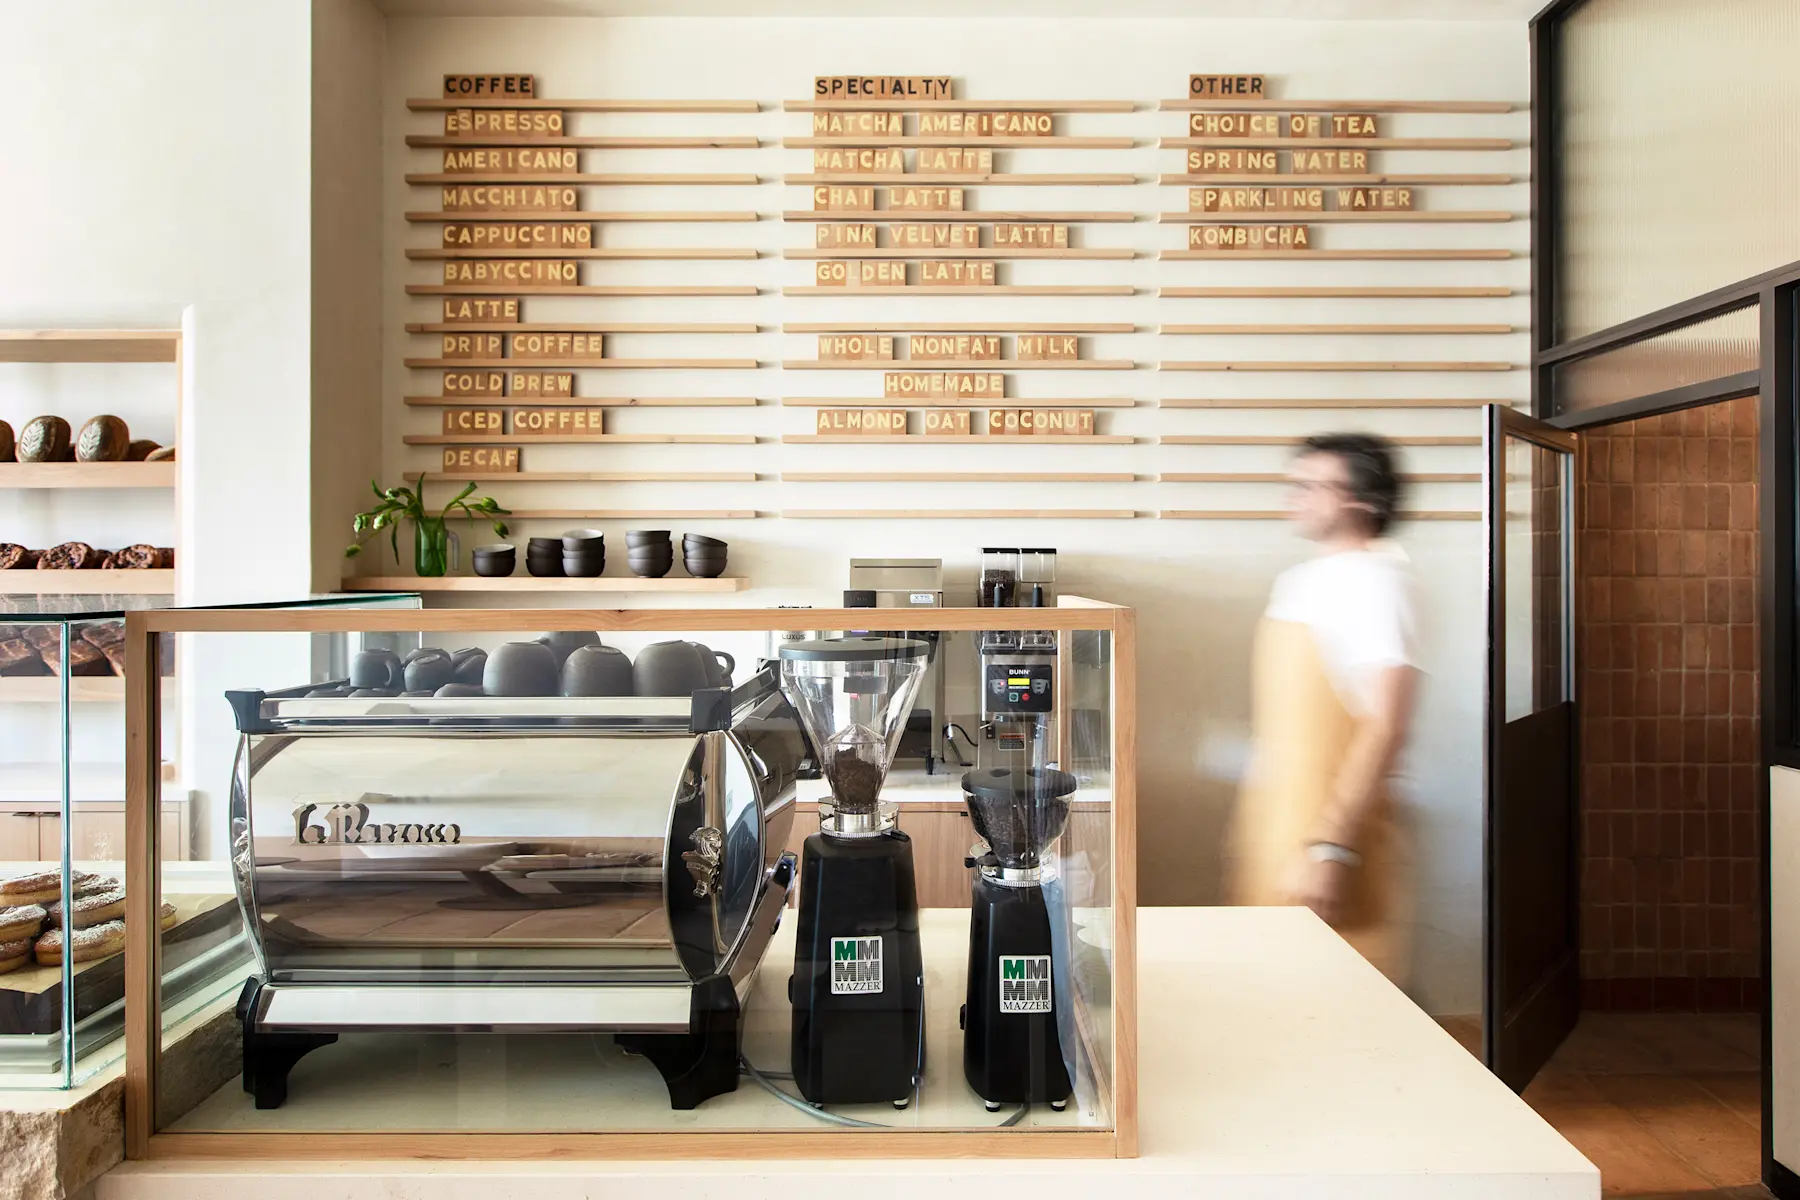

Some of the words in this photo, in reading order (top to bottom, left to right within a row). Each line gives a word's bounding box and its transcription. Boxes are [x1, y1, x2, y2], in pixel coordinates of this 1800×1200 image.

[445, 77, 532, 93] COFFEE
[815, 79, 951, 95] SPECIALTY
[1189, 77, 1264, 94] OTHER
[447, 112, 563, 131] ESPRESSO
[814, 114, 902, 132] MATCHA
[919, 115, 1052, 132] AMERICANO
[1190, 115, 1278, 133] CHOICE
[1290, 116, 1321, 133] OF
[1333, 116, 1377, 133] TEA
[444, 150, 577, 169] AMERICANO
[814, 150, 903, 168] MATCHA
[919, 151, 992, 168] LATTE
[1188, 151, 1277, 169] SPRING
[1292, 151, 1366, 169] WATER
[443, 189, 576, 206] MACCHIATO
[814, 188, 870, 205] CHAI
[889, 189, 962, 206] LATTE
[1189, 190, 1323, 207] SPARKLING
[1337, 190, 1411, 207] WATER
[443, 225, 591, 243] CAPPUCCINO
[817, 226, 875, 243] PINK
[889, 226, 978, 243] VELVET
[994, 226, 1067, 243] LATTE
[1189, 226, 1307, 244] KOMBUCHA
[444, 263, 577, 281] BABYCCINO
[817, 263, 906, 280] GOLDEN
[922, 263, 994, 280] LATTE
[444, 301, 517, 317] LATTE
[443, 336, 500, 353] DRIP
[513, 336, 602, 353] COFFEE
[819, 337, 893, 354] WHOLE
[911, 337, 999, 354] NONFAT
[1018, 337, 1076, 354] MILK
[444, 374, 502, 391] COLD
[513, 374, 573, 391] BREW
[885, 375, 1004, 392] HOMEMADE
[447, 412, 501, 429] ICED
[514, 412, 602, 429] COFFEE
[818, 412, 906, 429] ALMOND
[926, 412, 969, 429] OAT
[989, 411, 1092, 429] COCONUT
[444, 450, 518, 466] DECAF
[834, 982, 881, 991] MAZZER
[1003, 1001, 1050, 1010] MAZZER
